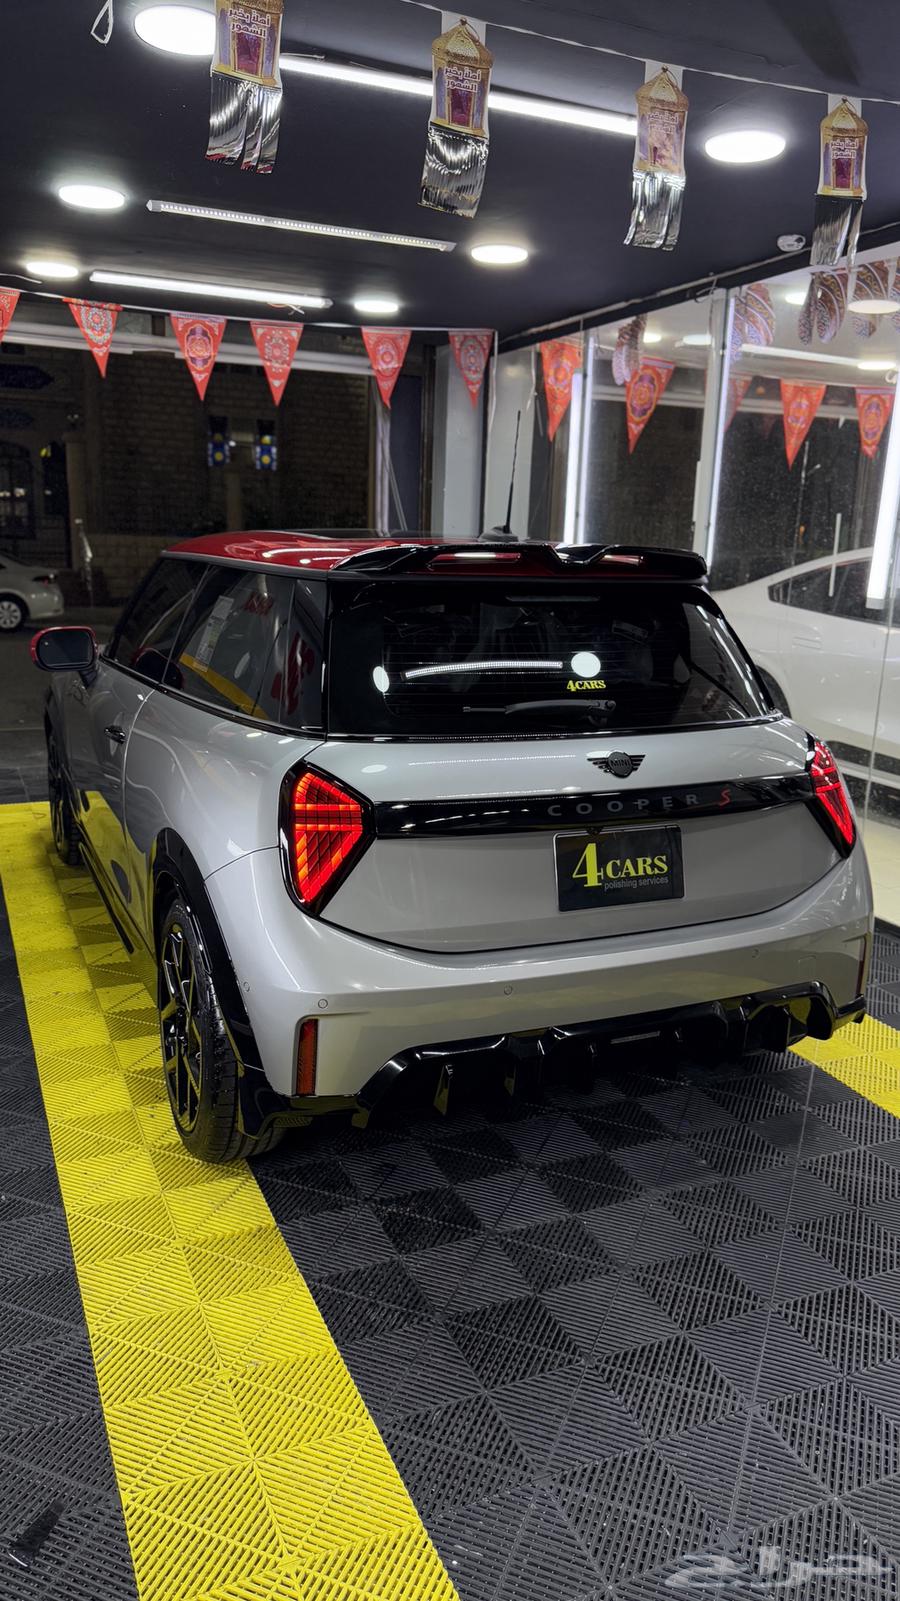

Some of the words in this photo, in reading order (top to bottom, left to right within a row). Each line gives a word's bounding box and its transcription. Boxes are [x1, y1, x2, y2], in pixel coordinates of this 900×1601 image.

[230, 22, 266, 38] الشهور
[446, 80, 477, 92] الشهور
[611, 759, 630, 767] MINI
[547, 794, 698, 816] COOPER
[718, 788, 731, 806] S
[604, 879, 637, 891] polishing
[639, 876, 668, 886] services
